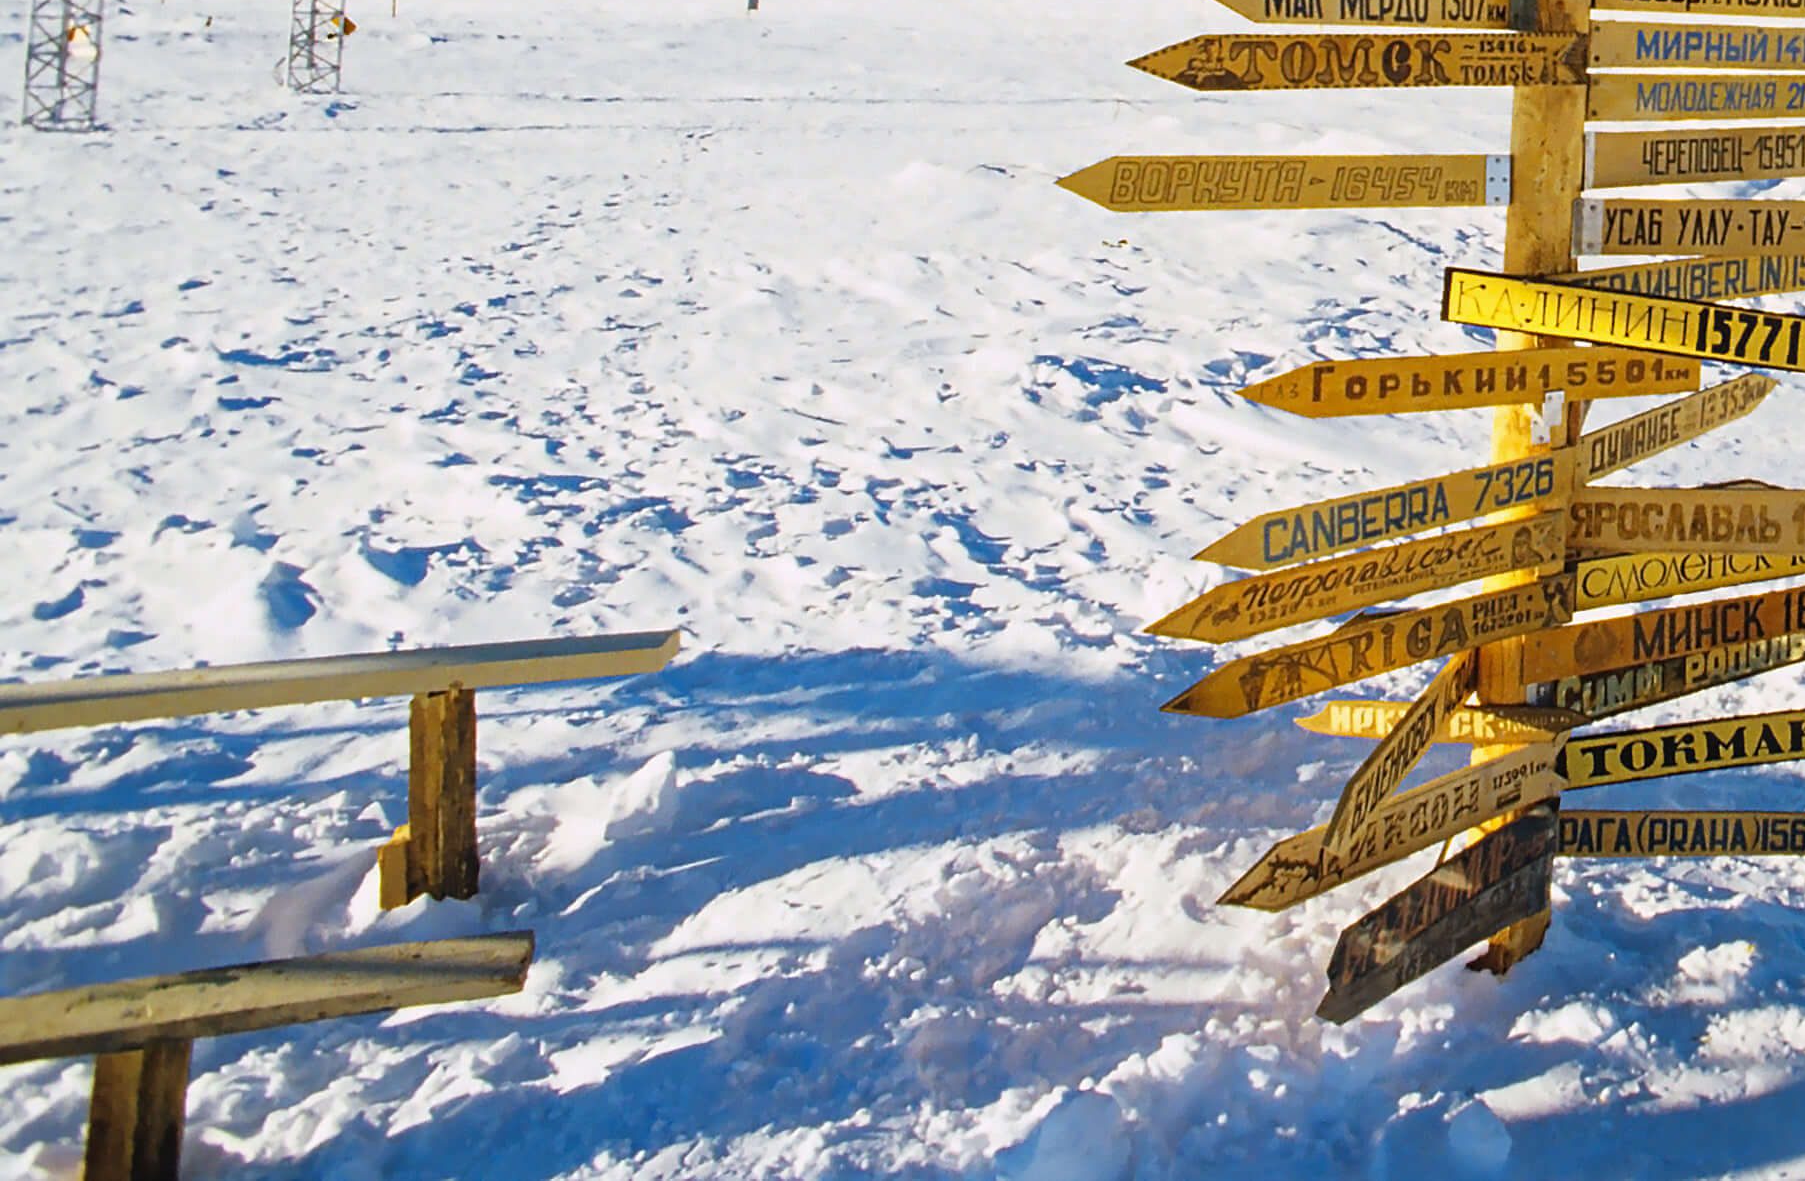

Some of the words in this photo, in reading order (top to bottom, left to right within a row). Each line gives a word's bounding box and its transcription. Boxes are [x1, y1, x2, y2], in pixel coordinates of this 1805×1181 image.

[1228, 38, 1453, 85] ТОМСК
[1635, 28, 1769, 63] МИРНЫЙ
[1635, 81, 1778, 113] МОЛОДЕЖНАЯ
[1109, 160, 1307, 205] ВОРКУТА
[1329, 166, 1444, 203] 16454
[1457, 280, 1689, 347] КАЛИНИН
[1695, 306, 1803, 366] 15771
[1588, 406, 1682, 477] ДУШАНБЕ
[1263, 481, 1450, 564] CANBERRA
[1473, 457, 1555, 513] 7326
[1569, 500, 1783, 546] ЯРОСЛАВЛЬ
[1347, 606, 1470, 678] RIGA
[1632, 598, 1766, 661] МИНСК
[1329, 705, 1496, 740] ИРКСК
